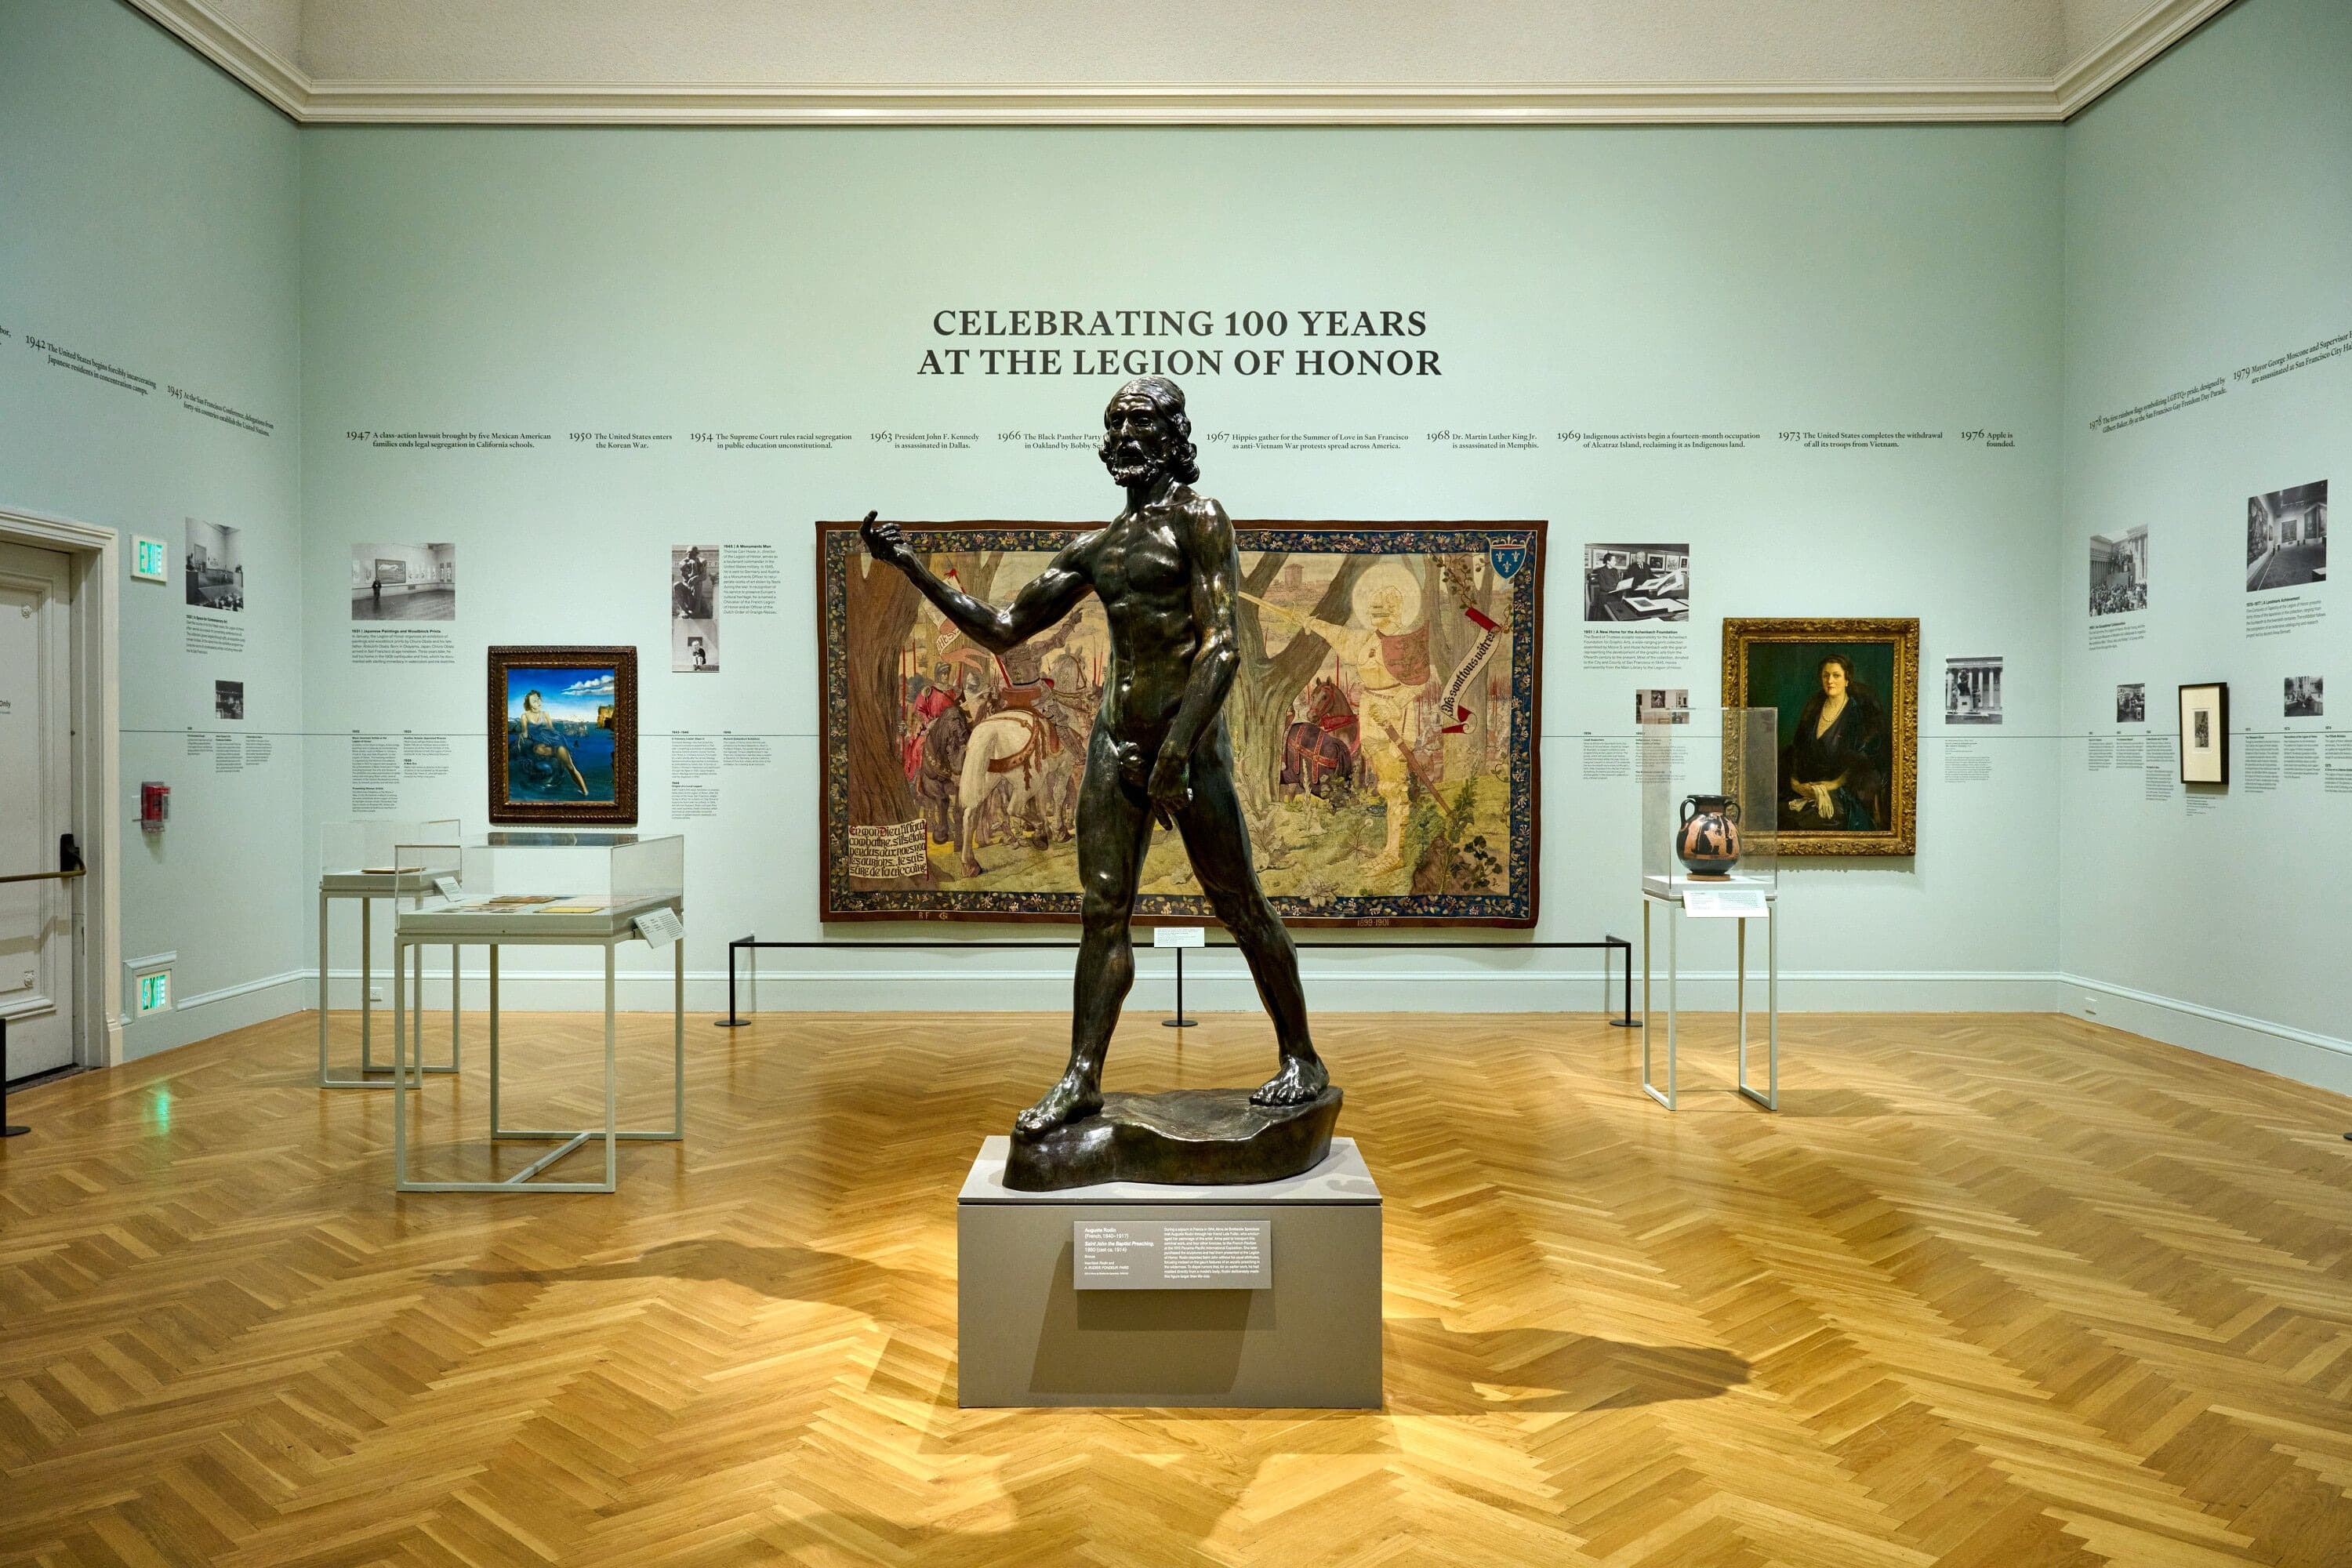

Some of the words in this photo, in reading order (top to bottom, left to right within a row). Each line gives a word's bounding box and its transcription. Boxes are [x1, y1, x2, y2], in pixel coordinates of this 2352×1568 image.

[933, 310, 1214, 337] CELEBRATING
[1225, 310, 1288, 337] 100
[1297, 310, 1426, 337] YEARS
[25, 335, 45, 350] 1942
[916, 349, 971, 376] AT
[979, 349, 1062, 376] THE
[1073, 349, 1224, 376] LEGION
[1233, 350, 1285, 376] OF
[1295, 350, 1443, 376] HONOR
[2232, 367, 2251, 382] 1979
[2251, 363, 2267, 374] Mayor
[2267, 357, 2286, 368] George
[2286, 348, 2309, 361] Moscone
[2309, 342, 2319, 353] and
[2319, 334, 2349, 350] Supervisor
[347, 431, 370, 441] 1947
[441, 432, 468, 441] brought
[468, 432, 477, 441] by
[569, 433, 592, 441] 1950
[690, 433, 713, 442] 1954
[729, 433, 758, 441] Supreme
[815, 434, 852, 442] segregation
[870, 430, 892, 442] 1963
[926, 433, 942, 442] John
[950, 433, 979, 442] Kennedy
[997, 430, 1021, 441] 1966
[1083, 433, 1101, 442] Party
[1207, 430, 1229, 442] 1967
[1232, 434, 1258, 442] Hippies
[1258, 434, 1279, 442] gather
[1427, 430, 1450, 442] 1968
[1512, 433, 1528, 442] King
[1557, 430, 1581, 442] 1969
[1583, 432, 1619, 441] Indigenous
[1647, 432, 1665, 441] begin
[1724, 433, 1760, 441] occupation
[1778, 431, 1801, 441] 1973
[1860, 432, 1894, 441] completes
[1961, 429, 1984, 440] 1976
[1987, 431, 2006, 441] Apple
[414, 441, 430, 450] legal
[430, 441, 467, 450] segregation
[724, 441, 745, 451] public
[1061, 442, 1069, 451] by
[1070, 442, 1091, 451] Bobby
[1299, 442, 1327, 452] protests
[1327, 442, 1349, 452] spread
[1506, 441, 1539, 451] Memphis.
[1619, 441, 1642, 450] Island,
[1642, 441, 1677, 450] reclaiming
[1691, 441, 1728, 450] Indigenous
[1829, 441, 1851, 450] troops
[140, 540, 163, 576] EXIT
